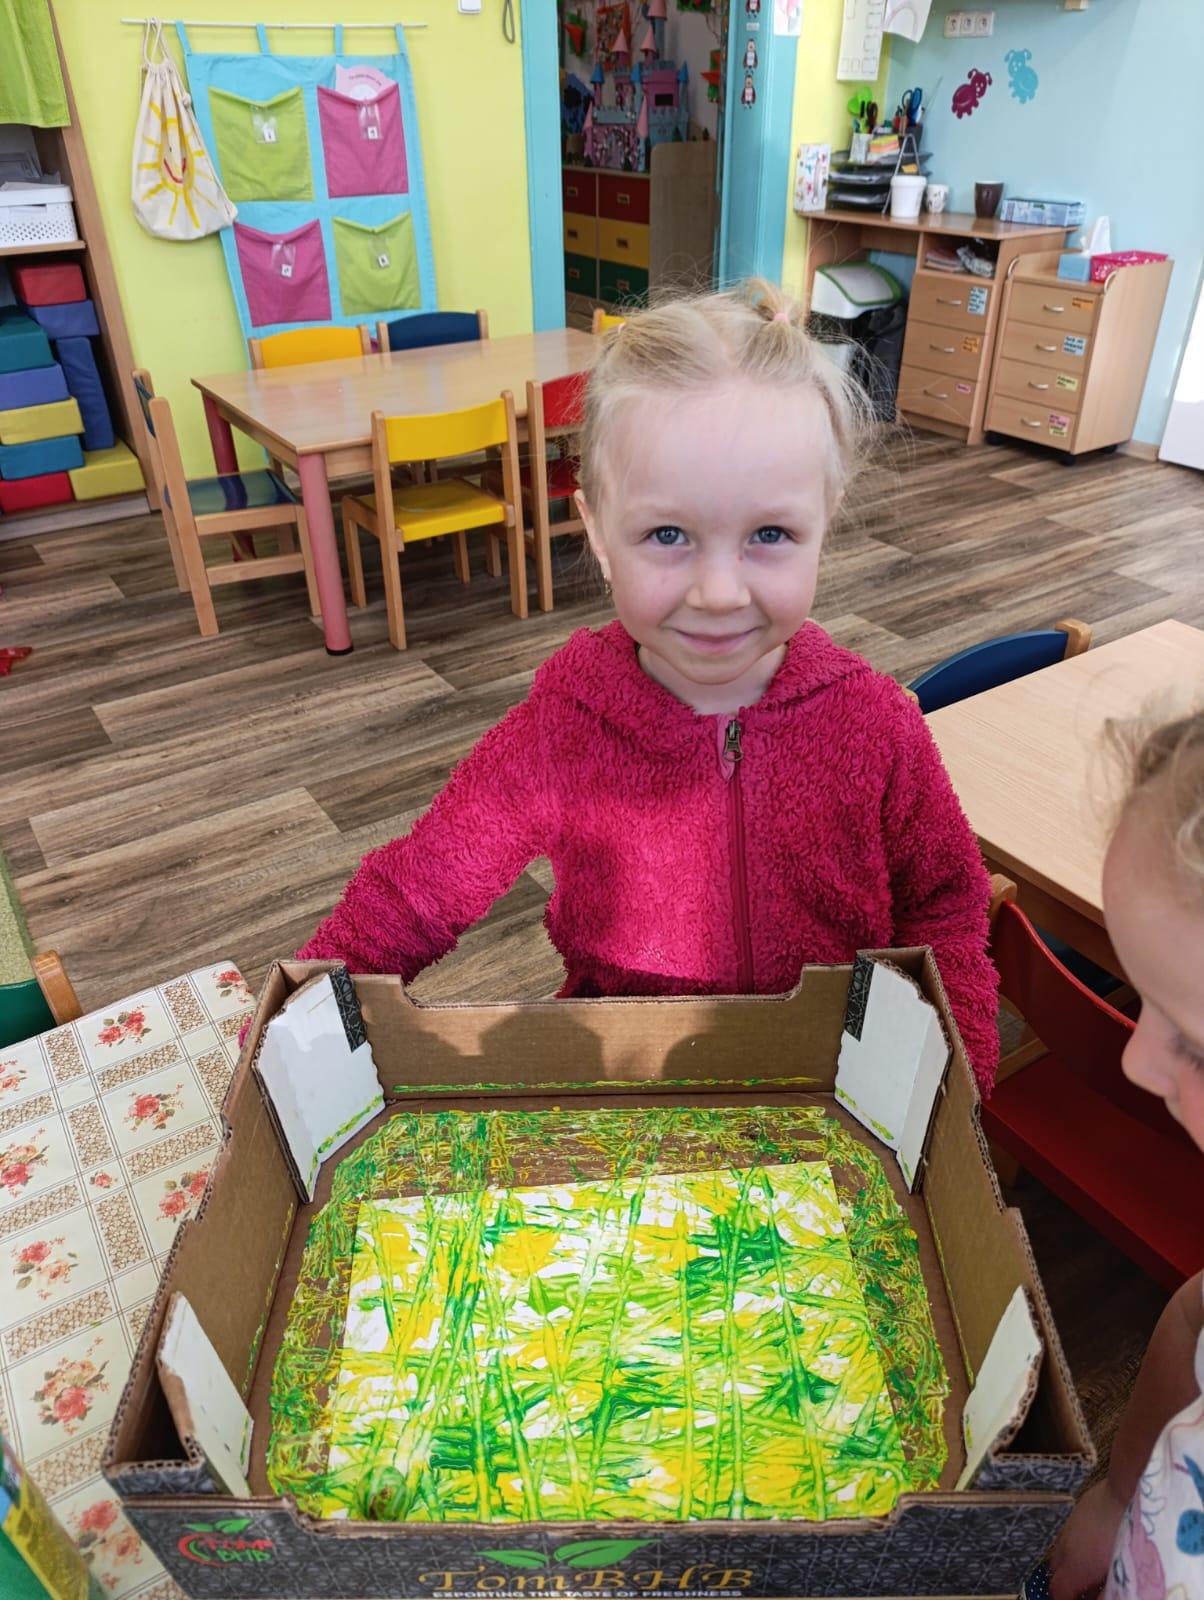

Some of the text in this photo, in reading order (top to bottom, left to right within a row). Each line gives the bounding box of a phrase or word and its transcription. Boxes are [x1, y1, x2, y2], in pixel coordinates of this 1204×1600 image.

[418, 1564, 753, 1591] TomBHB
[432, 1590, 742, 1598] EXPORTING THE TASTE OF FRESHNESS
